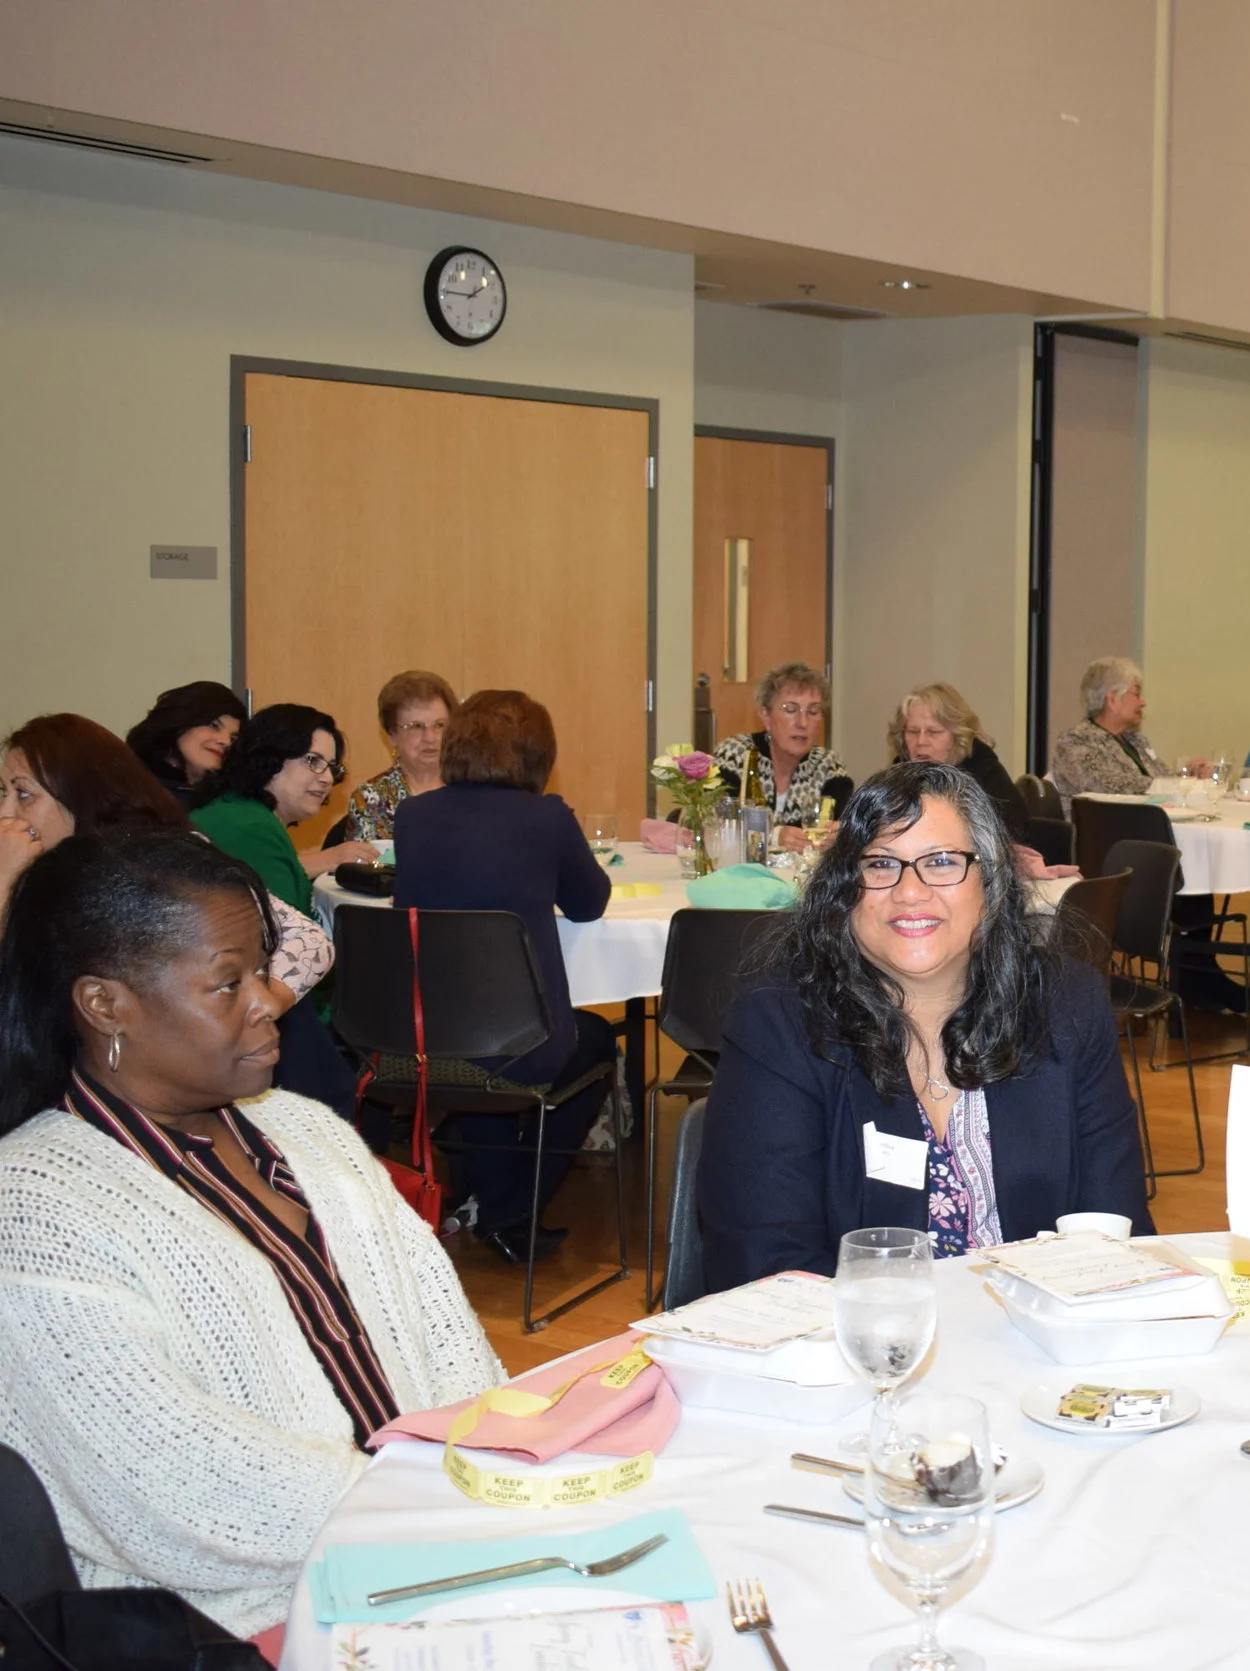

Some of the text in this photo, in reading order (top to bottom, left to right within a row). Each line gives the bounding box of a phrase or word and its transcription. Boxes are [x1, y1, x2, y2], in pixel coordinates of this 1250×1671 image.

[620, 1460, 641, 1474] KEEP
[494, 1477, 524, 1488] KEEP
[562, 1476, 592, 1487] KEEP
[613, 1472, 645, 1490] COUPON
[486, 1489, 531, 1502] COUPON
[552, 1488, 597, 1502] COUPON
